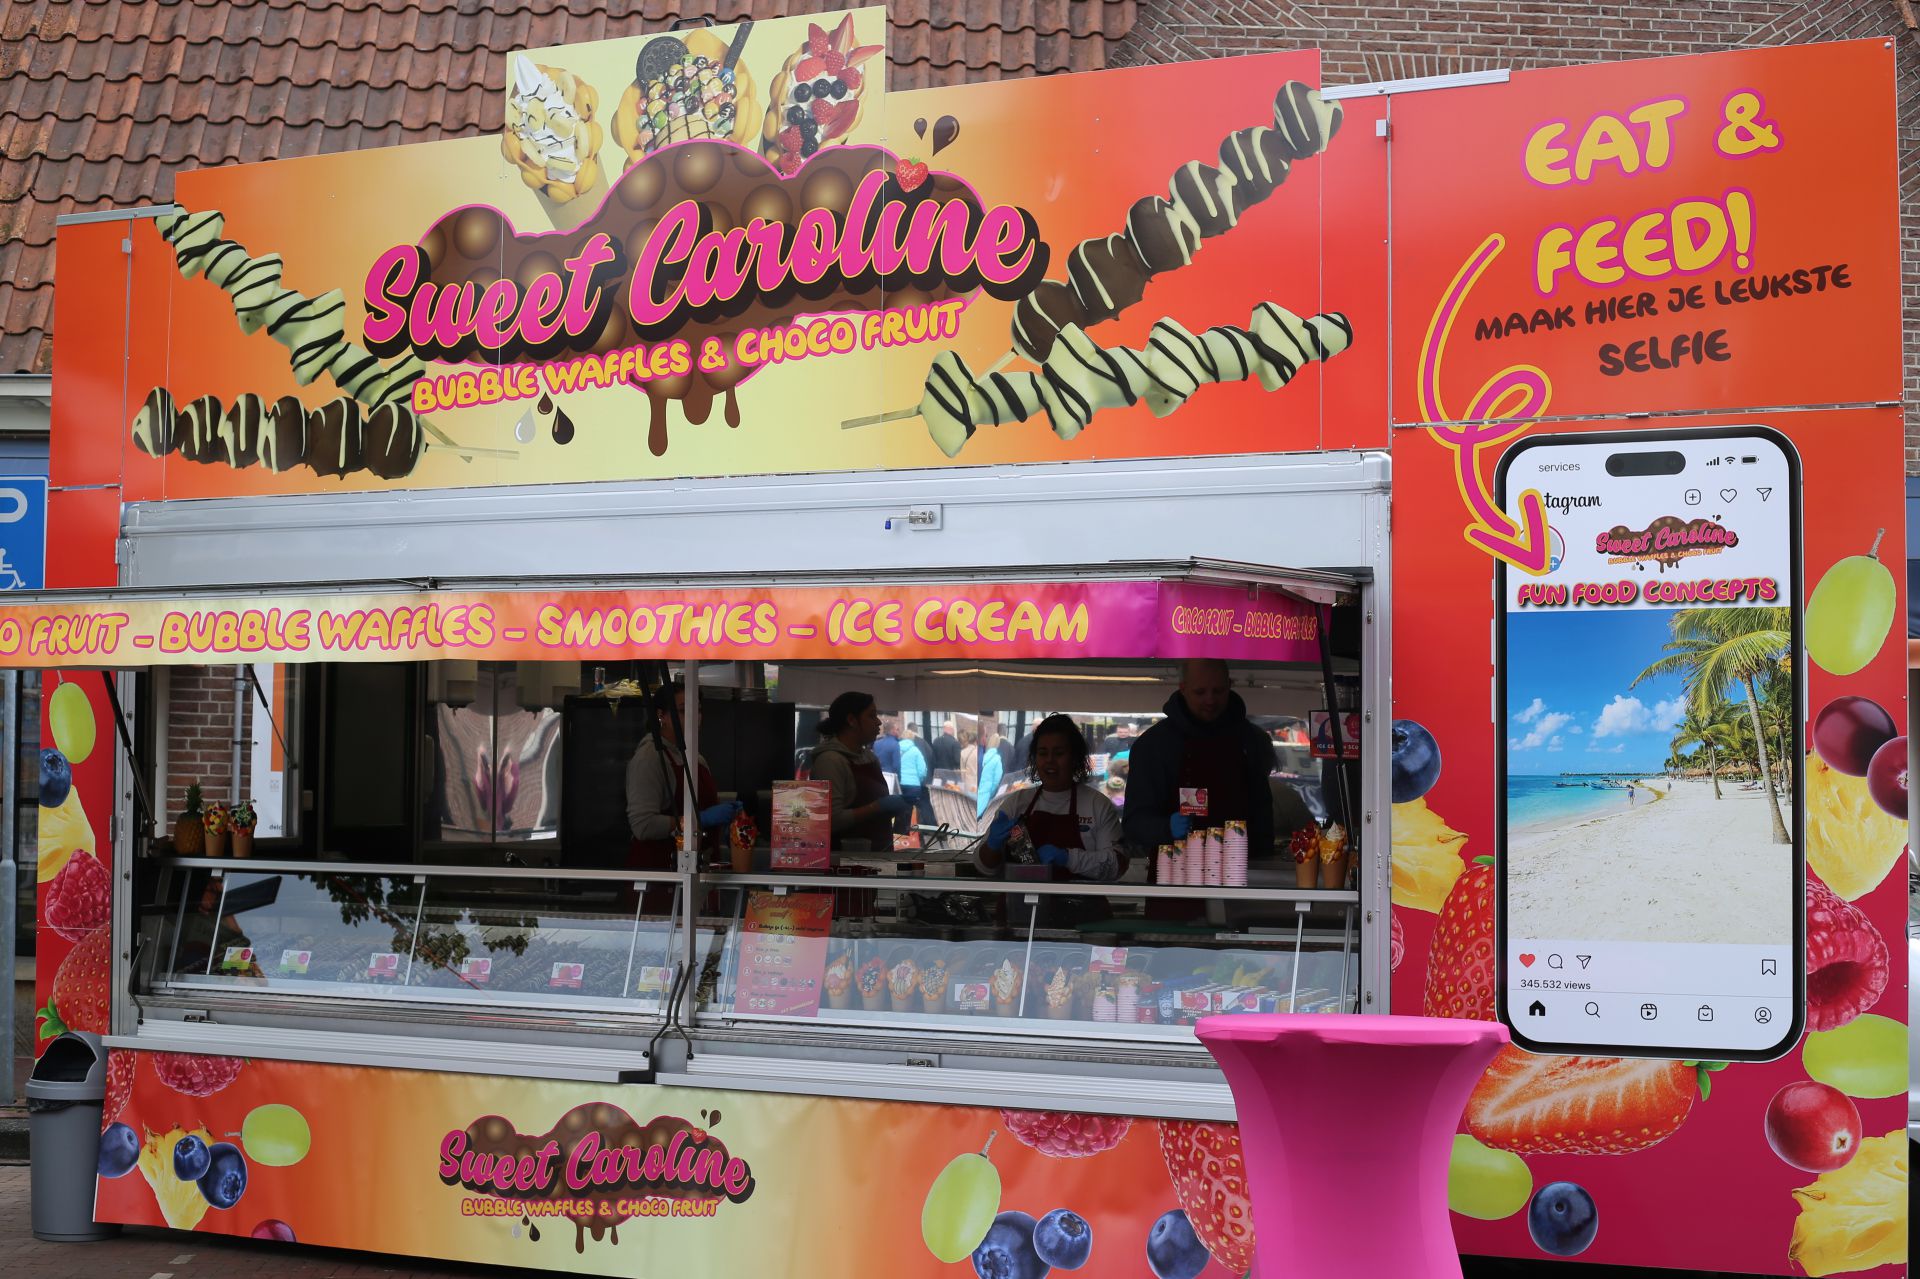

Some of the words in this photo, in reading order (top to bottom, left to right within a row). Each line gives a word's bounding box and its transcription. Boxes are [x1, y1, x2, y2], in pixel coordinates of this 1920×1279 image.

[1523, 98, 1687, 187] EAT
[1715, 90, 1781, 157] &
[363, 232, 616, 349] Sweet
[628, 169, 1035, 325] Caroline
[1535, 189, 1753, 296] FEED!
[1475, 305, 1576, 341] MAAK
[1585, 291, 1659, 324] HIER
[1668, 284, 1706, 313] JE
[1714, 263, 1852, 306] LEUKSTE
[411, 358, 539, 415] BUBBLE
[546, 338, 692, 399] WAFFLES
[699, 340, 727, 373] &
[736, 317, 856, 366] CHOCO
[860, 299, 968, 350] FRUIT
[1597, 328, 1732, 377] SELFIE
[1538, 461, 1581, 473] services
[1543, 491, 1603, 515] tagram
[1595, 531, 1653, 554] Sweet
[1654, 521, 1737, 551] Caroline
[1517, 581, 1568, 606] FUN
[1572, 579, 1638, 606] FOOD
[1643, 576, 1779, 604] CONCEPTS
[28, 612, 130, 657] FRUIT
[159, 606, 310, 654] BUBBLE
[317, 602, 496, 652] WAFFLES
[536, 602, 779, 650] SMOOTHIES
[826, 598, 903, 647] ICE
[912, 596, 1090, 646] CREAM
[1519, 978, 1562, 990] 345.532
[1563, 979, 1592, 991] views
[439, 1128, 560, 1191] Sweet
[565, 1129, 751, 1196] Caroline
[461, 1197, 523, 1217] BUBBLE
[526, 1197, 594, 1217] WAFFLES
[598, 1198, 612, 1216] &
[616, 1198, 670, 1217] CHOCO
[671, 1198, 719, 1218] FRUIT
